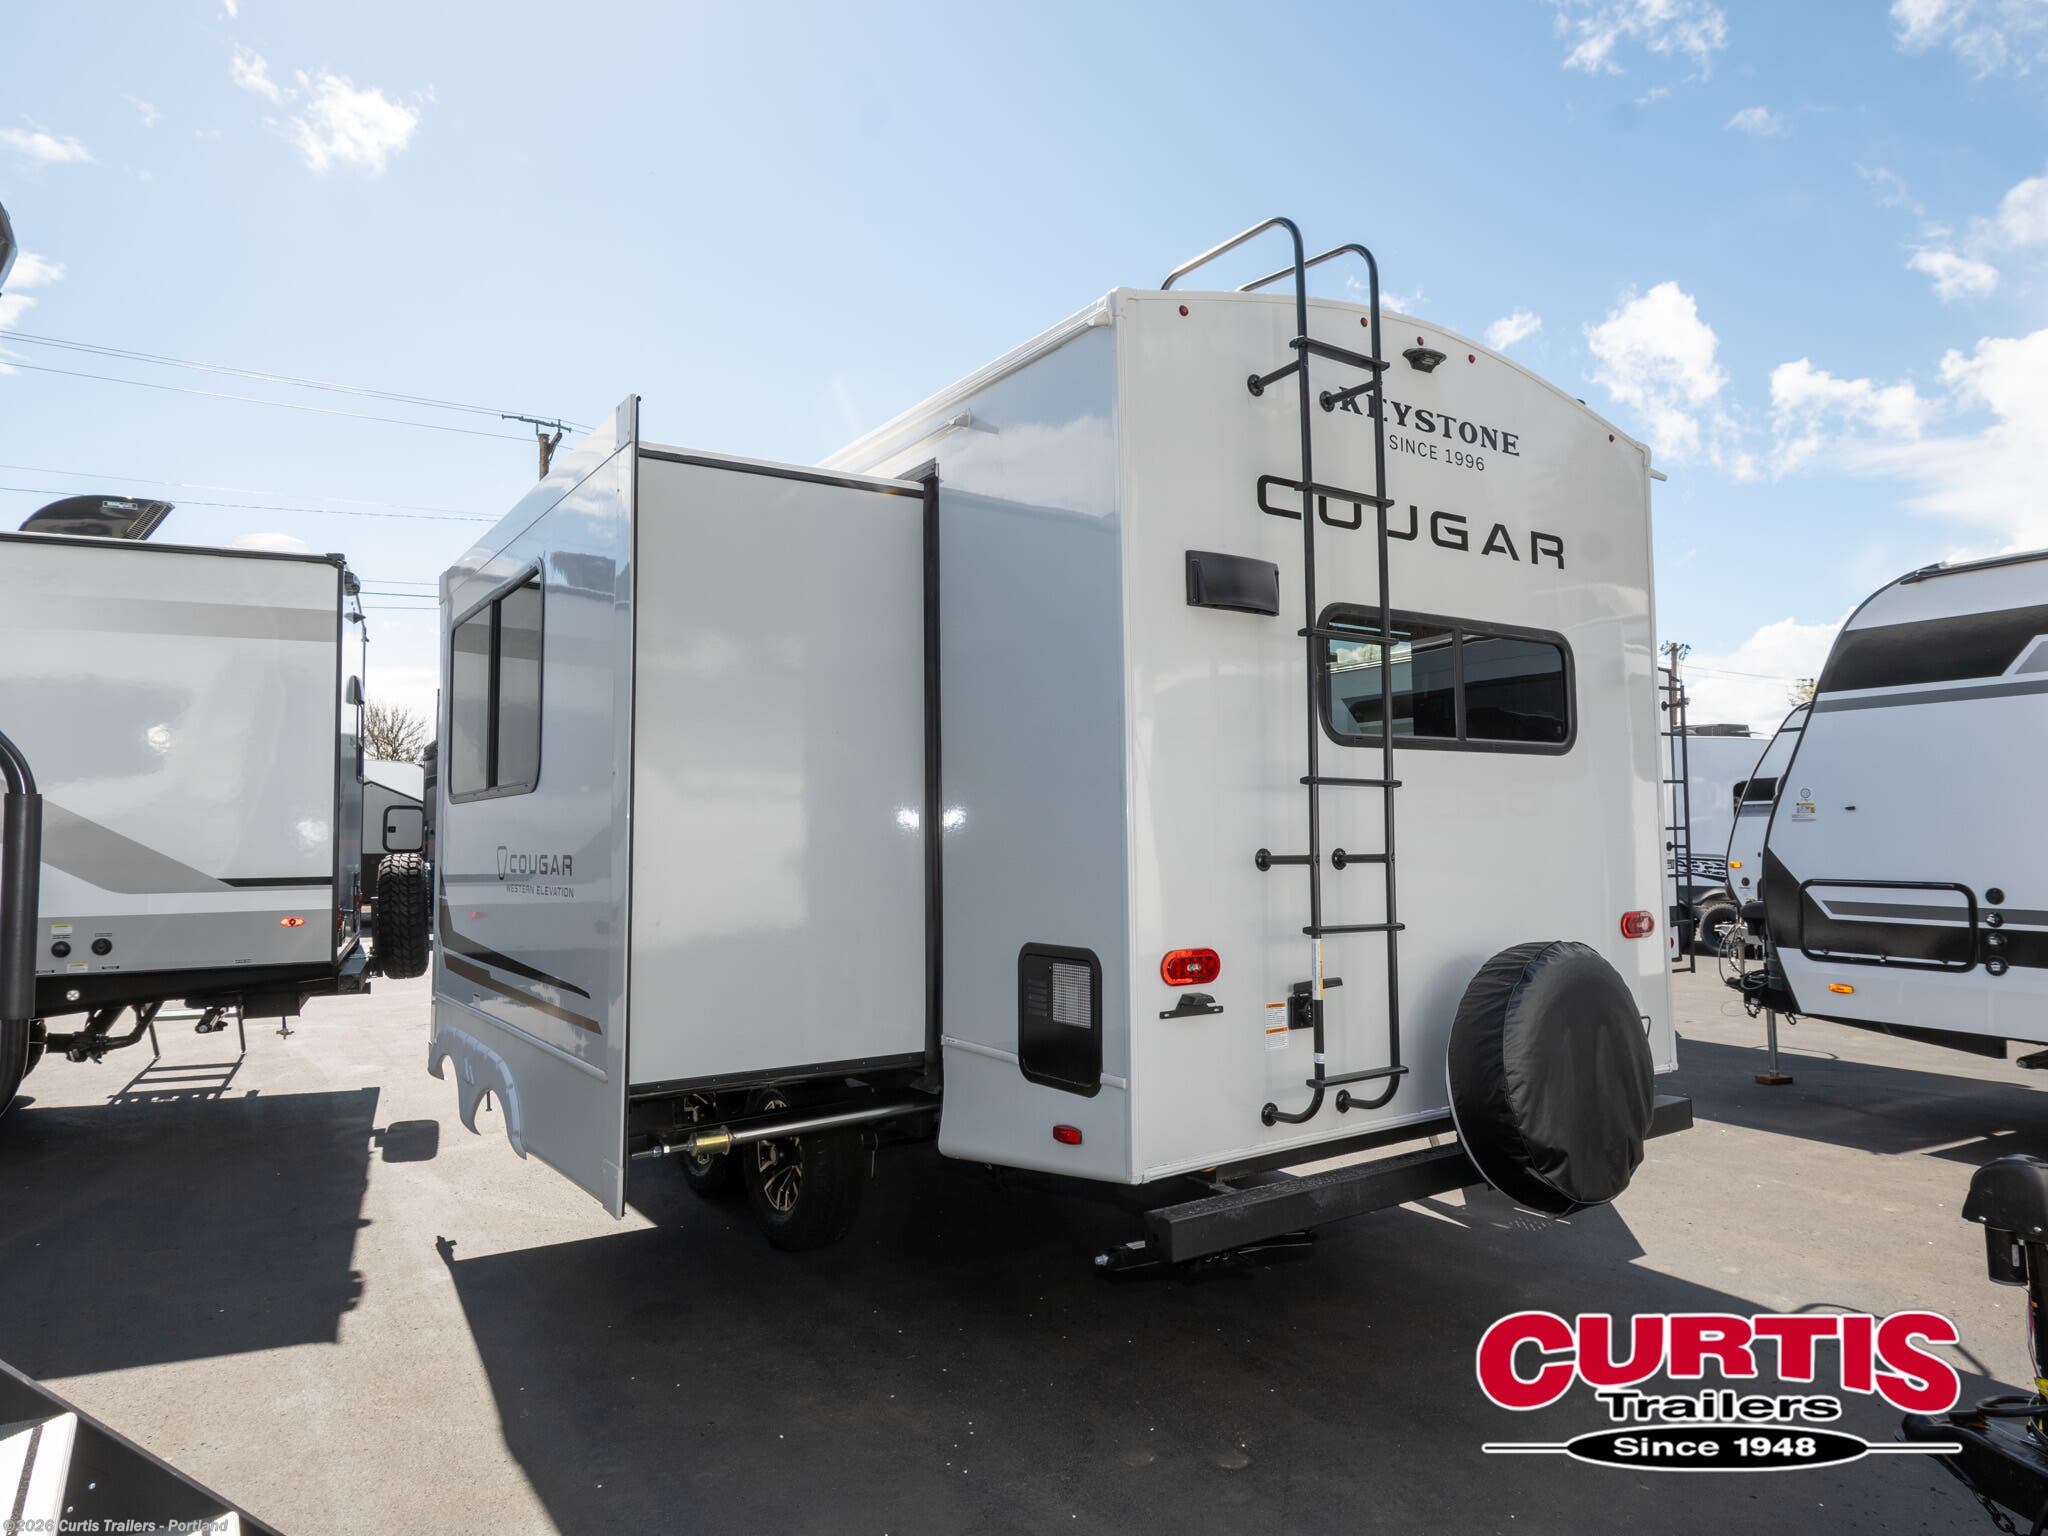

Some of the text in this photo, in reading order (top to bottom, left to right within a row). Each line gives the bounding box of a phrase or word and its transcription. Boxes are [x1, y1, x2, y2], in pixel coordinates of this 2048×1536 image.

[1389, 434, 1485, 471] SINCE 1996
[1257, 474, 1565, 570] COUGAR
[510, 854, 572, 876] COUGAR
[507, 884, 574, 897] WESTERN ELEVATION
